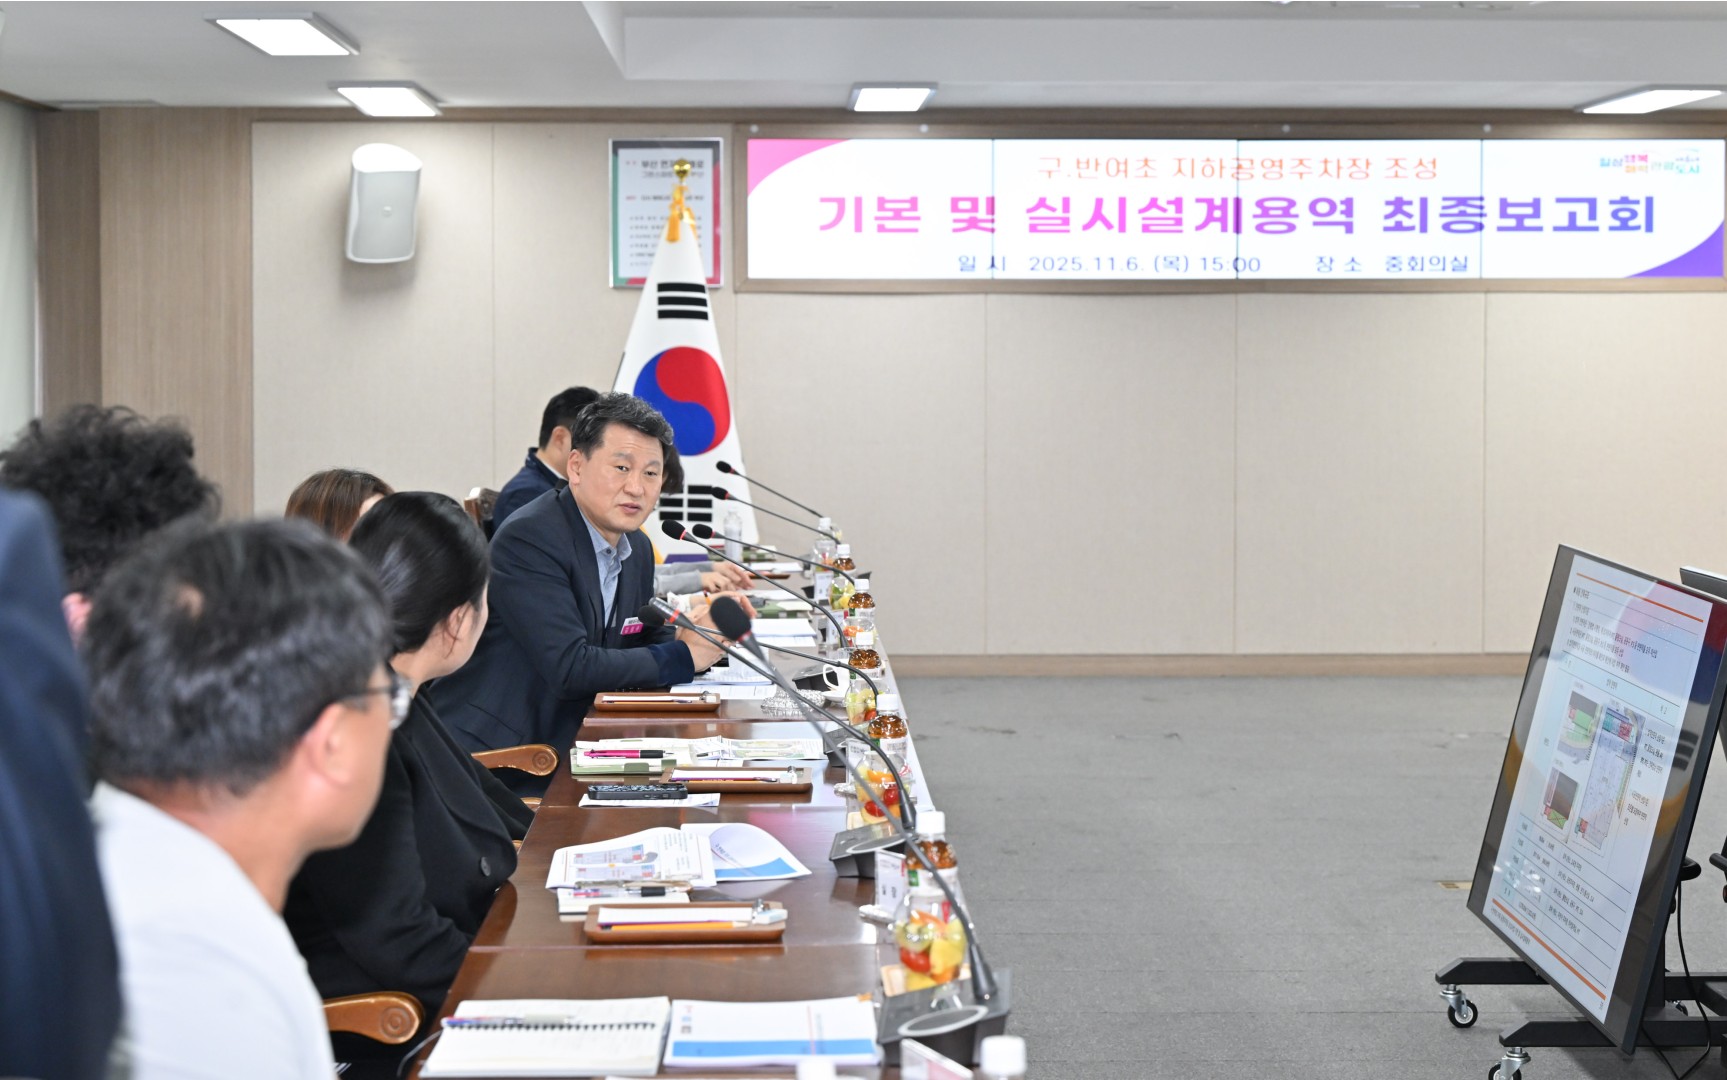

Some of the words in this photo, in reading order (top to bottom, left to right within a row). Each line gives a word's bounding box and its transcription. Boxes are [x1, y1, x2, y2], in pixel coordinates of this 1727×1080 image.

[1037, 157, 1159, 180] 구.반여초
[1172, 157, 1373, 180] 지하공영주차장
[1384, 157, 1438, 180] 조성
[818, 196, 922, 233] 기본
[950, 195, 997, 234] 및
[1025, 196, 1355, 235] 실시설계용역
[1382, 195, 1655, 235] 최종보고회
[1028, 257, 1145, 272] 2025.11.6.
[1153, 256, 1190, 273] (목)
[1199, 257, 1262, 273] 15:00
[1384, 255, 1469, 273] 중회의실
